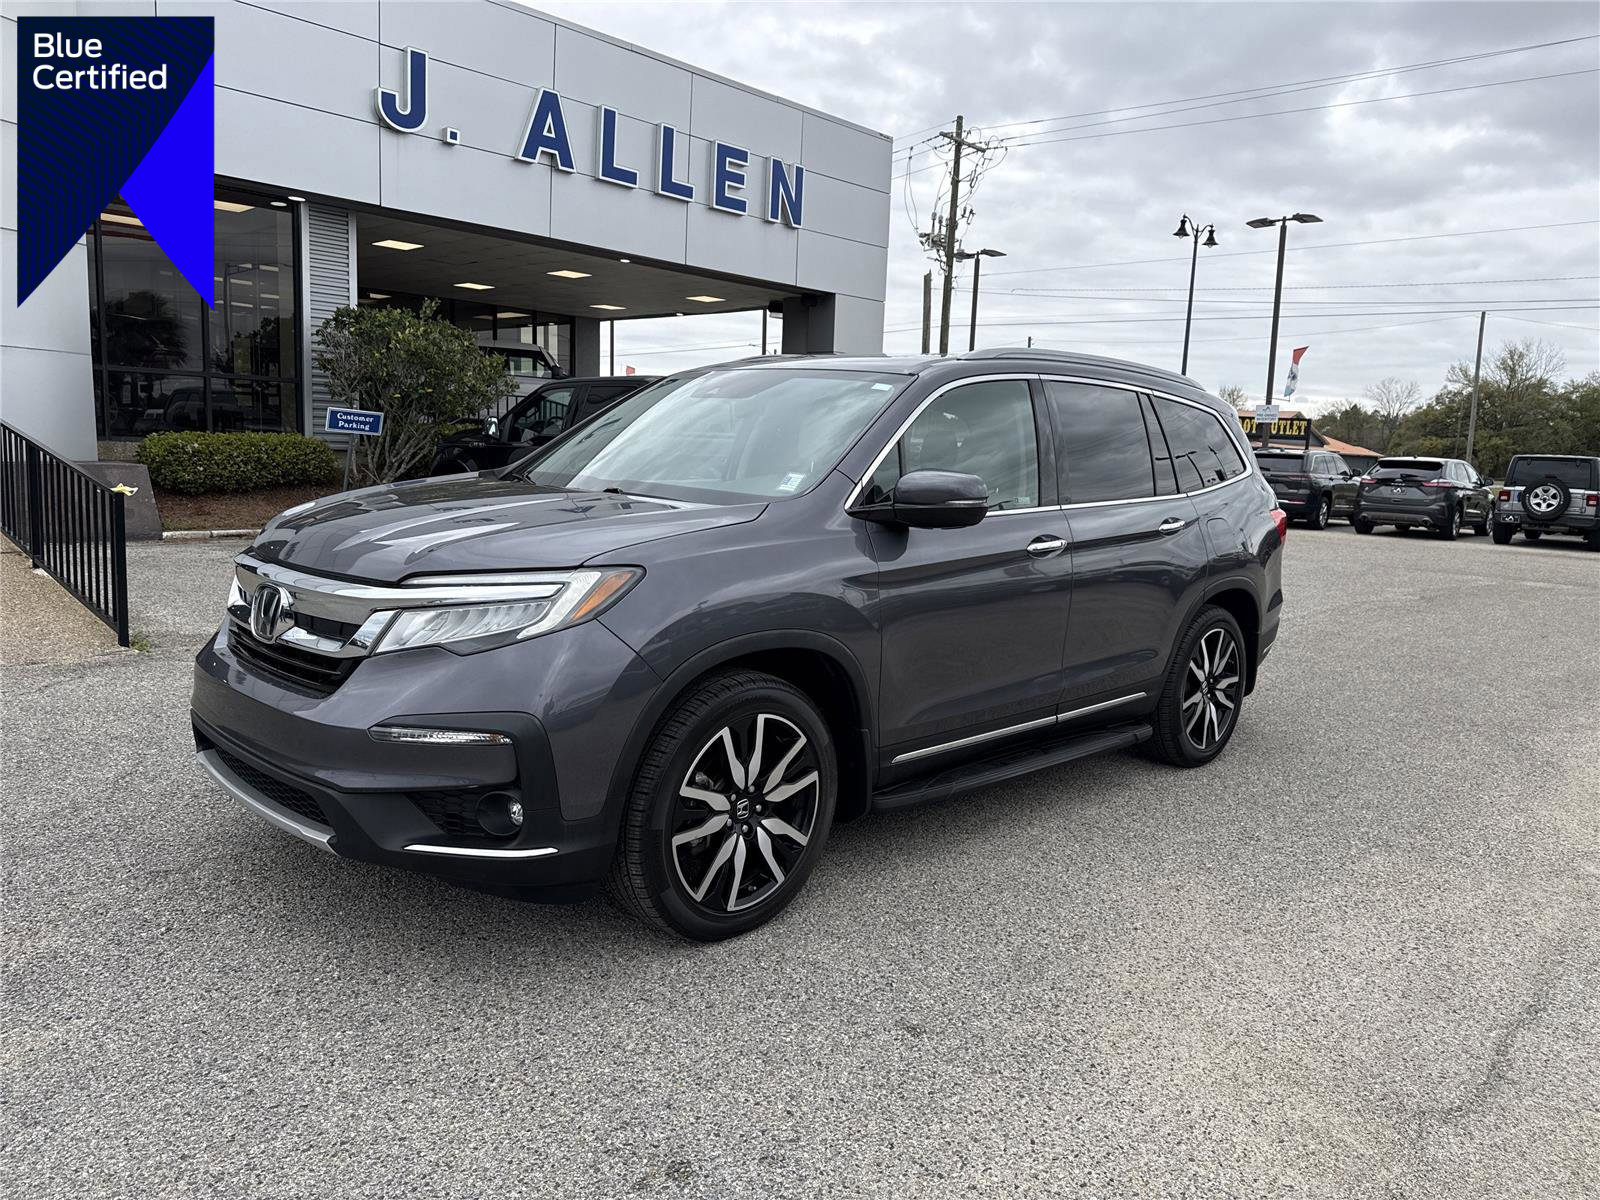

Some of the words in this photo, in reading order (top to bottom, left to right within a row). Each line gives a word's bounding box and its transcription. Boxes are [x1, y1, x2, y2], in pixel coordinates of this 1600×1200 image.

[374, 46, 461, 146] J.
[514, 86, 806, 229] ALLEN
[337, 412, 374, 422] Customer
[338, 420, 370, 430] Parking
[1241, 419, 1257, 433] OT
[1271, 419, 1307, 435] UTLET
